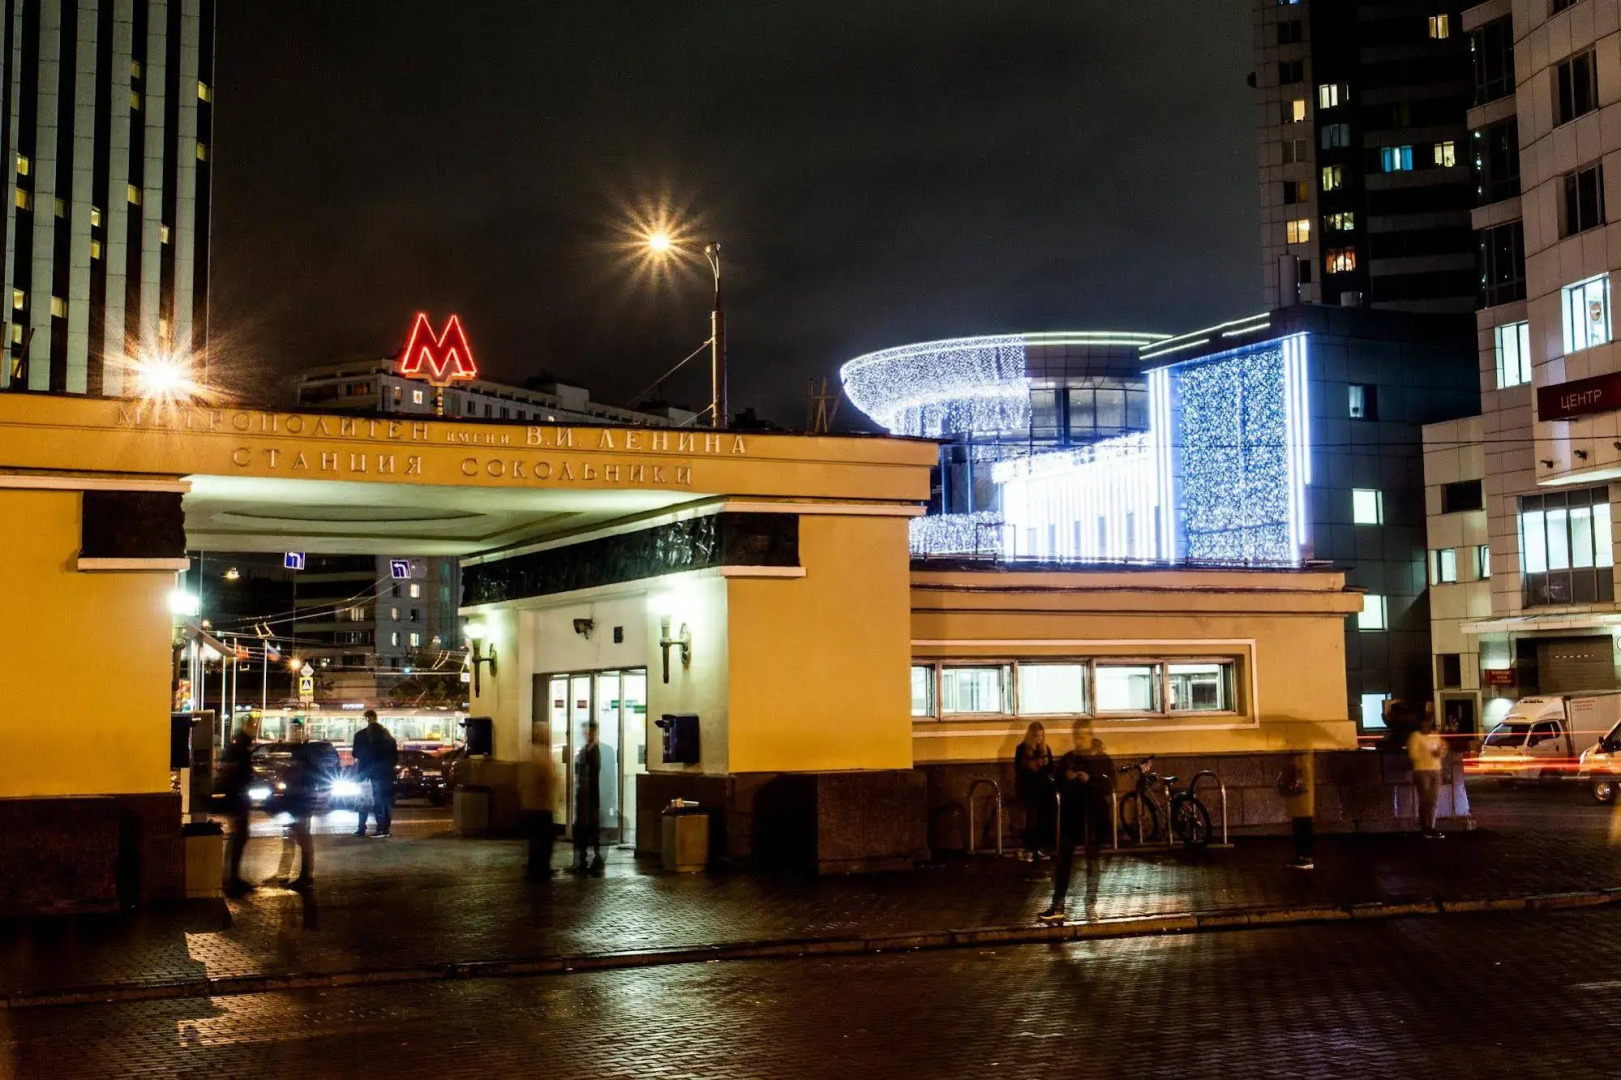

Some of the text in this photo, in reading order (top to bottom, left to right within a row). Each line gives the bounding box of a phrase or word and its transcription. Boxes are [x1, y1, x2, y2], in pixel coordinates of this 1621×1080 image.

[400, 312, 478, 378] М
[1560, 389, 1603, 411] ЦЕНТР
[598, 429, 746, 454] ЛЕНИНА
[233, 447, 692, 485] СТАНЦИЯ СОКОЛЬНИКИ
